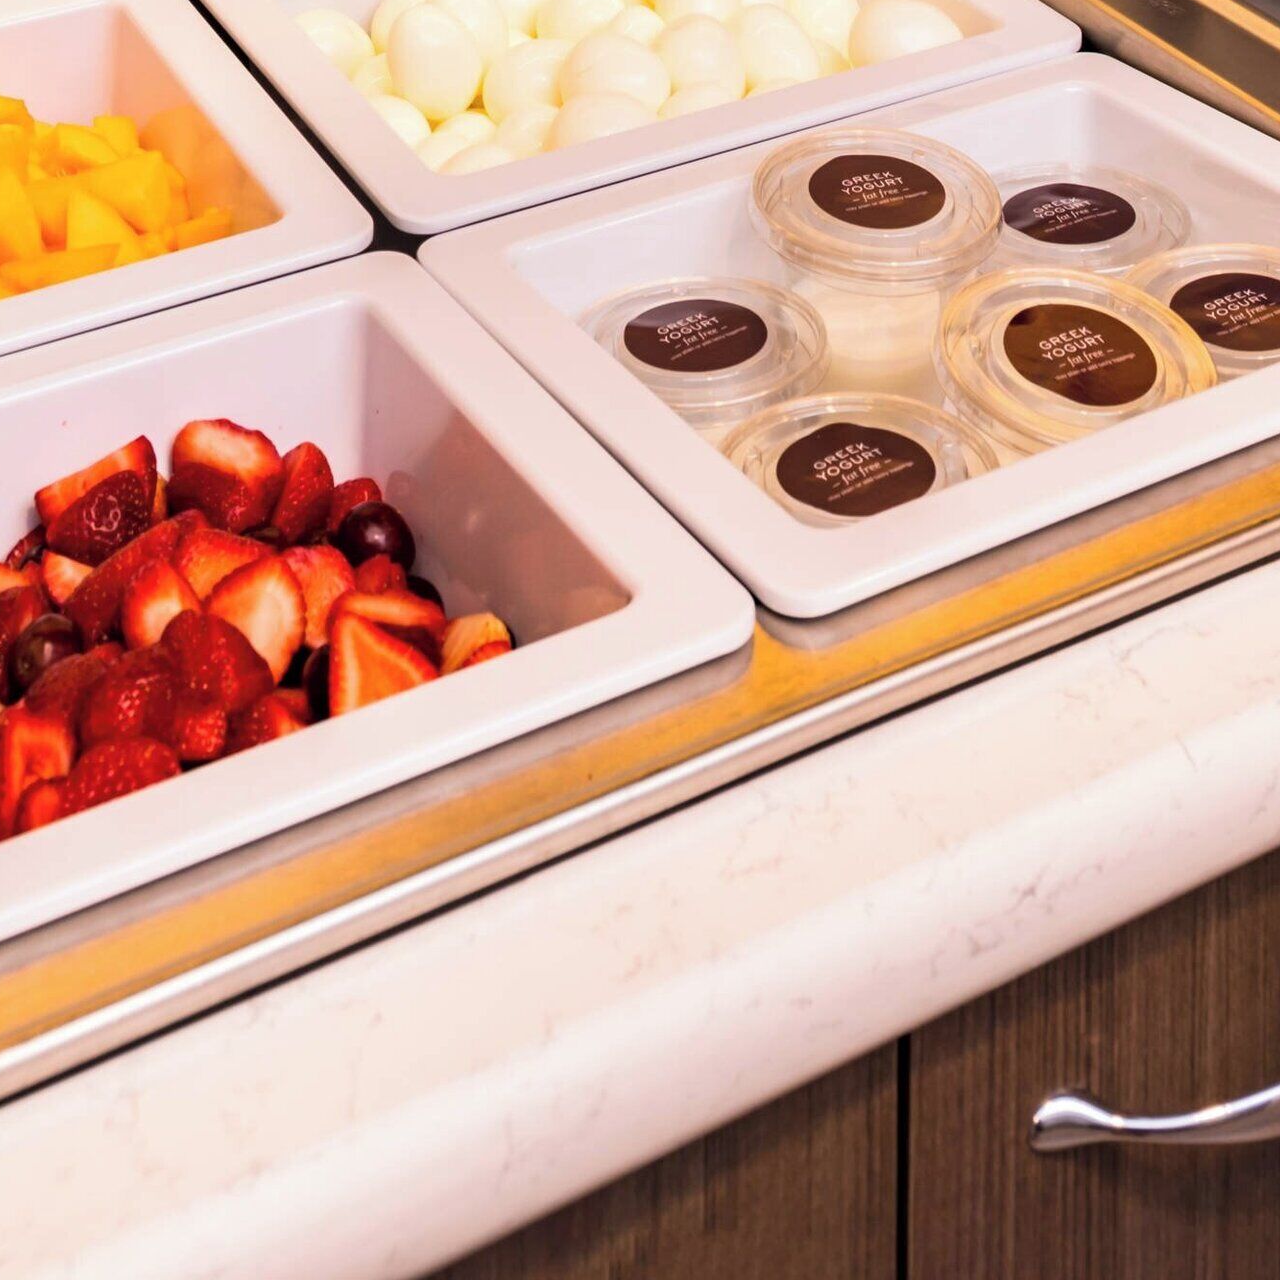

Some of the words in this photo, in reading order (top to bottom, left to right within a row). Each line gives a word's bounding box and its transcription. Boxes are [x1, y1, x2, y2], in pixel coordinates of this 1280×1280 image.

[841, 177, 904, 196] YOGURT
[842, 171, 894, 187] GREEK
[862, 191, 878, 202] fat
[880, 188, 899, 198] free
[1203, 288, 1256, 310] GREEK
[1205, 293, 1268, 320] YOGURT
[657, 313, 708, 334] GREEK
[1230, 313, 1245, 324] fat
[1245, 305, 1267, 318] free
[659, 316, 719, 344] YOGURT
[683, 335, 698, 346] fat
[698, 328, 718, 340] free
[1039, 326, 1092, 350] GREEK
[1042, 334, 1105, 361] YOGURT
[1067, 356, 1083, 367] fat
[1083, 350, 1103, 363] free
[813, 442, 869, 470] GREEK
[816, 447, 883, 481] YOGURT
[842, 471, 858, 485] fat
[859, 462, 880, 477] free
